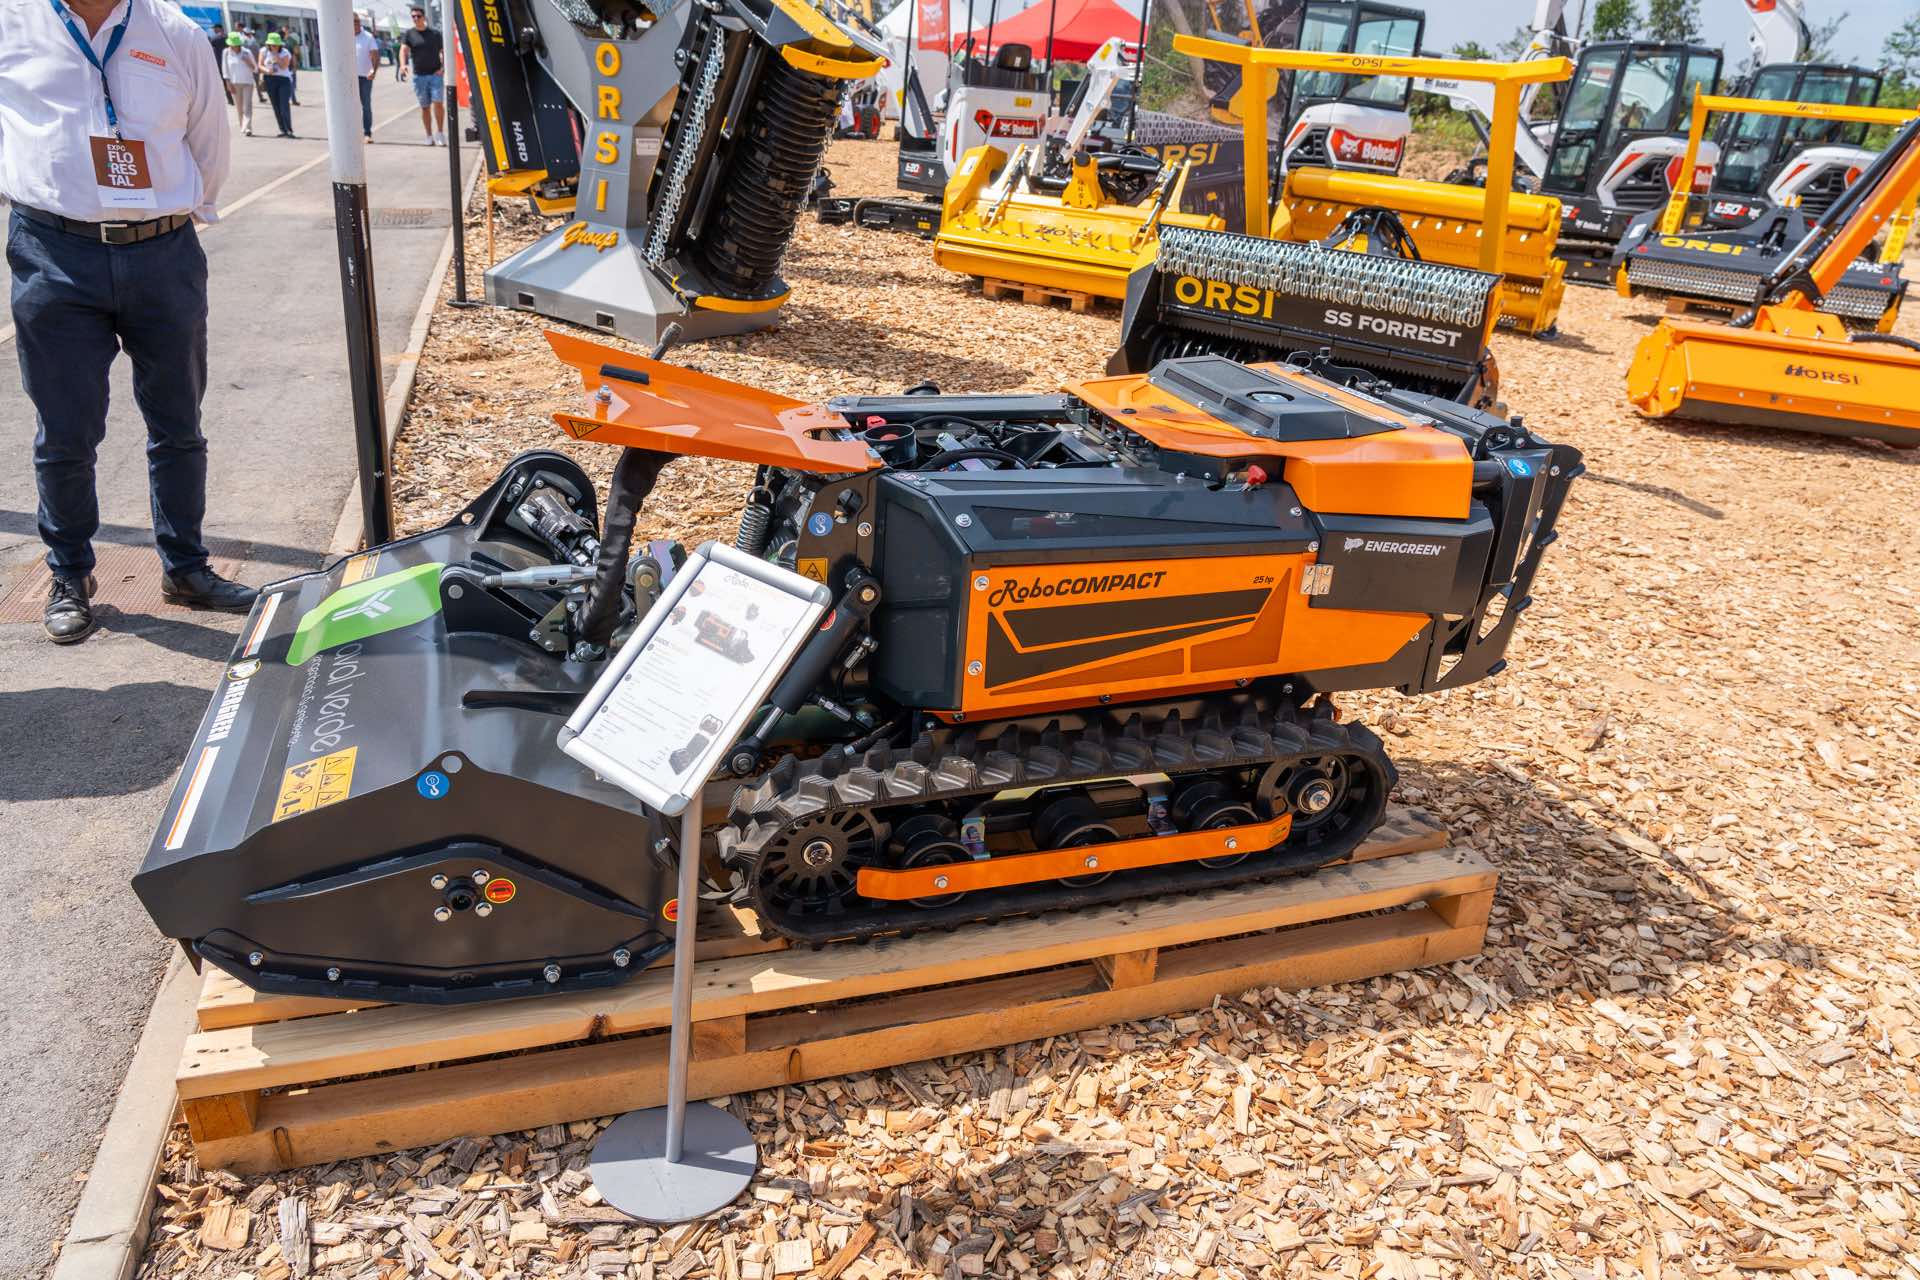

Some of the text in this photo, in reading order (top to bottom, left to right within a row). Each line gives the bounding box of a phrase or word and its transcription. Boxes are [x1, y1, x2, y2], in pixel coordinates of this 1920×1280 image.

[512, 121, 528, 163] HARD
[594, 42, 622, 212] ORSI
[107, 143, 126, 151] EXPO
[108, 151, 134, 164] FLO
[108, 174, 135, 187] TAL
[111, 163, 137, 176] RES
[560, 220, 619, 253] Group
[1661, 237, 1743, 256] ORSI
[1175, 276, 1277, 319] ORSI
[1323, 309, 1463, 348] SS FORREST
[1364, 540, 1441, 556] ENERGREEN
[988, 571, 1167, 608] RoboCOMPACT
[1253, 576, 1265, 584] 25
[206, 678, 250, 743] ENERGREEN
[310, 684, 355, 753] verde
